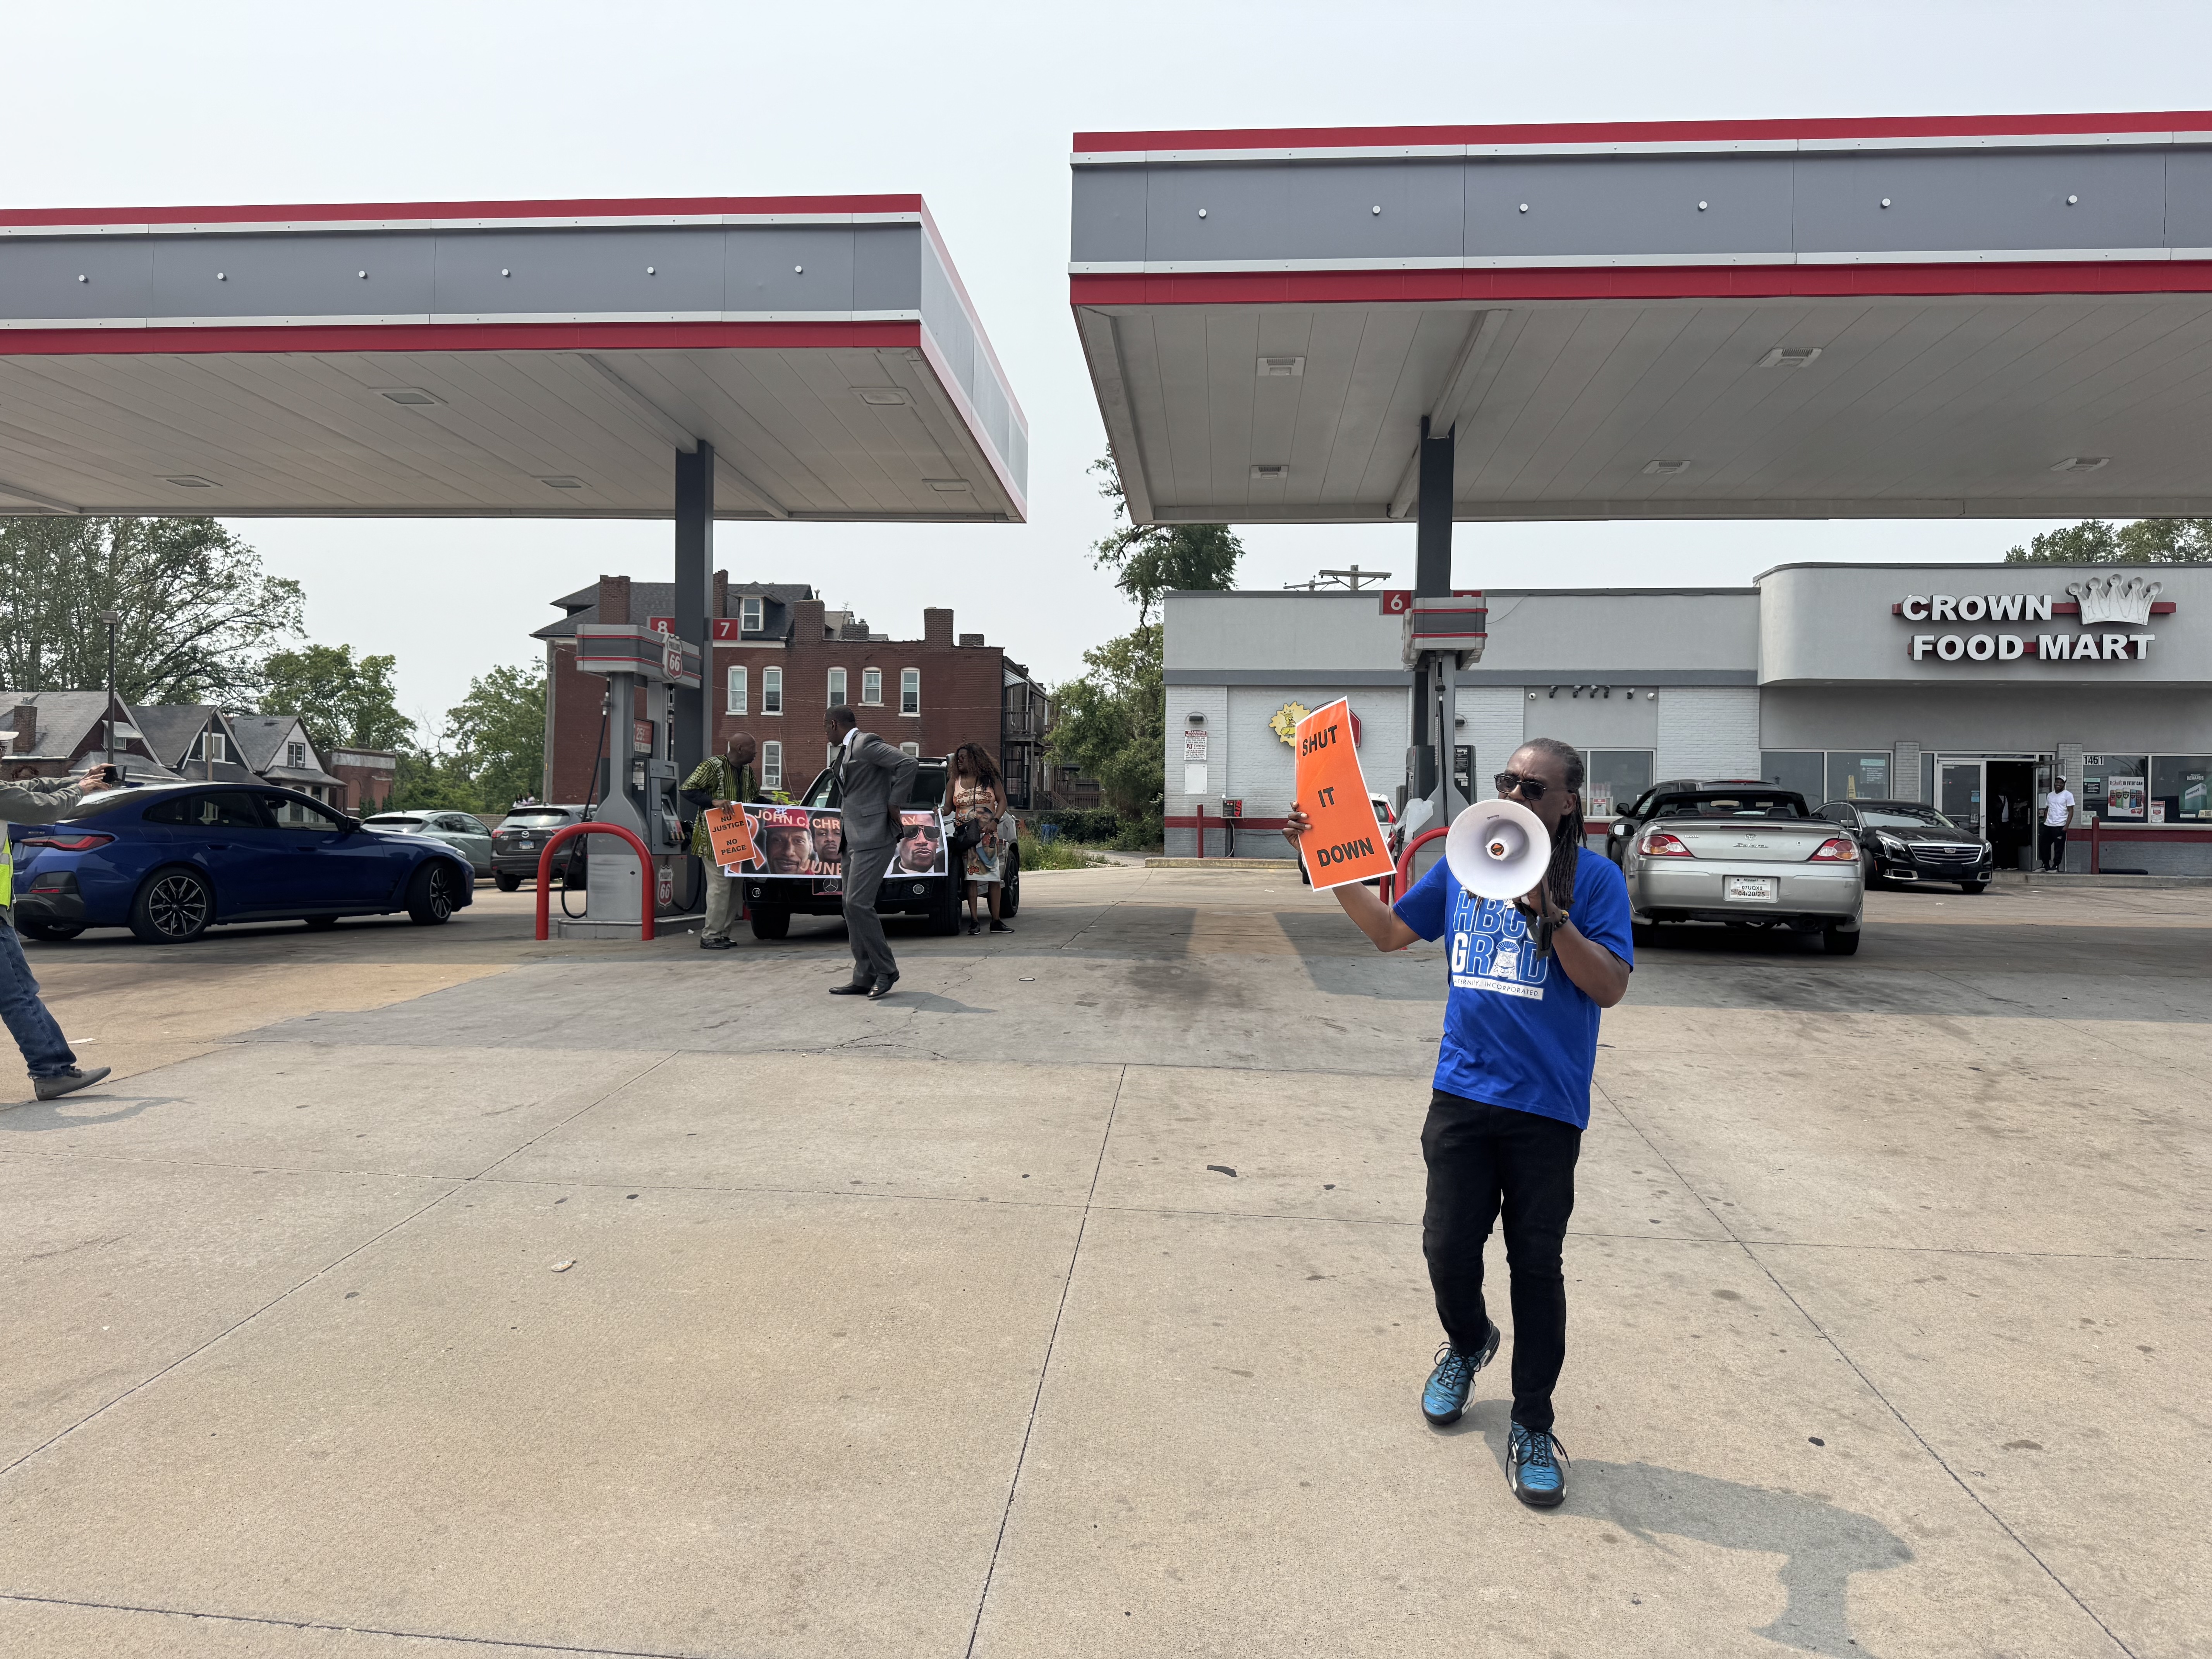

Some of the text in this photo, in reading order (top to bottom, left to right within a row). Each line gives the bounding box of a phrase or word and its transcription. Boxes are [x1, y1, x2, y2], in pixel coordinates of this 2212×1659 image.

[1391, 594, 1403, 610] 6
[1902, 594, 2052, 621] CROWN
[657, 620, 668, 633] 8
[720, 622, 730, 637] 7
[1911, 633, 2155, 661] FOOD MART
[669, 654, 680, 672] 66
[1302, 725, 1337, 756] SHUT
[2084, 756, 2103, 765] 1451
[1318, 787, 1334, 807] IT
[754, 809, 793, 825] JOHN
[712, 821, 745, 832] JUSTICE
[721, 845, 747, 855] PEACE
[1317, 837, 1374, 867] DOWN
[660, 883, 671, 899] 66
[1453, 891, 1539, 941] HBC
[1451, 932, 1548, 984] GRAD
[1484, 982, 1539, 996] INCORPORATED
